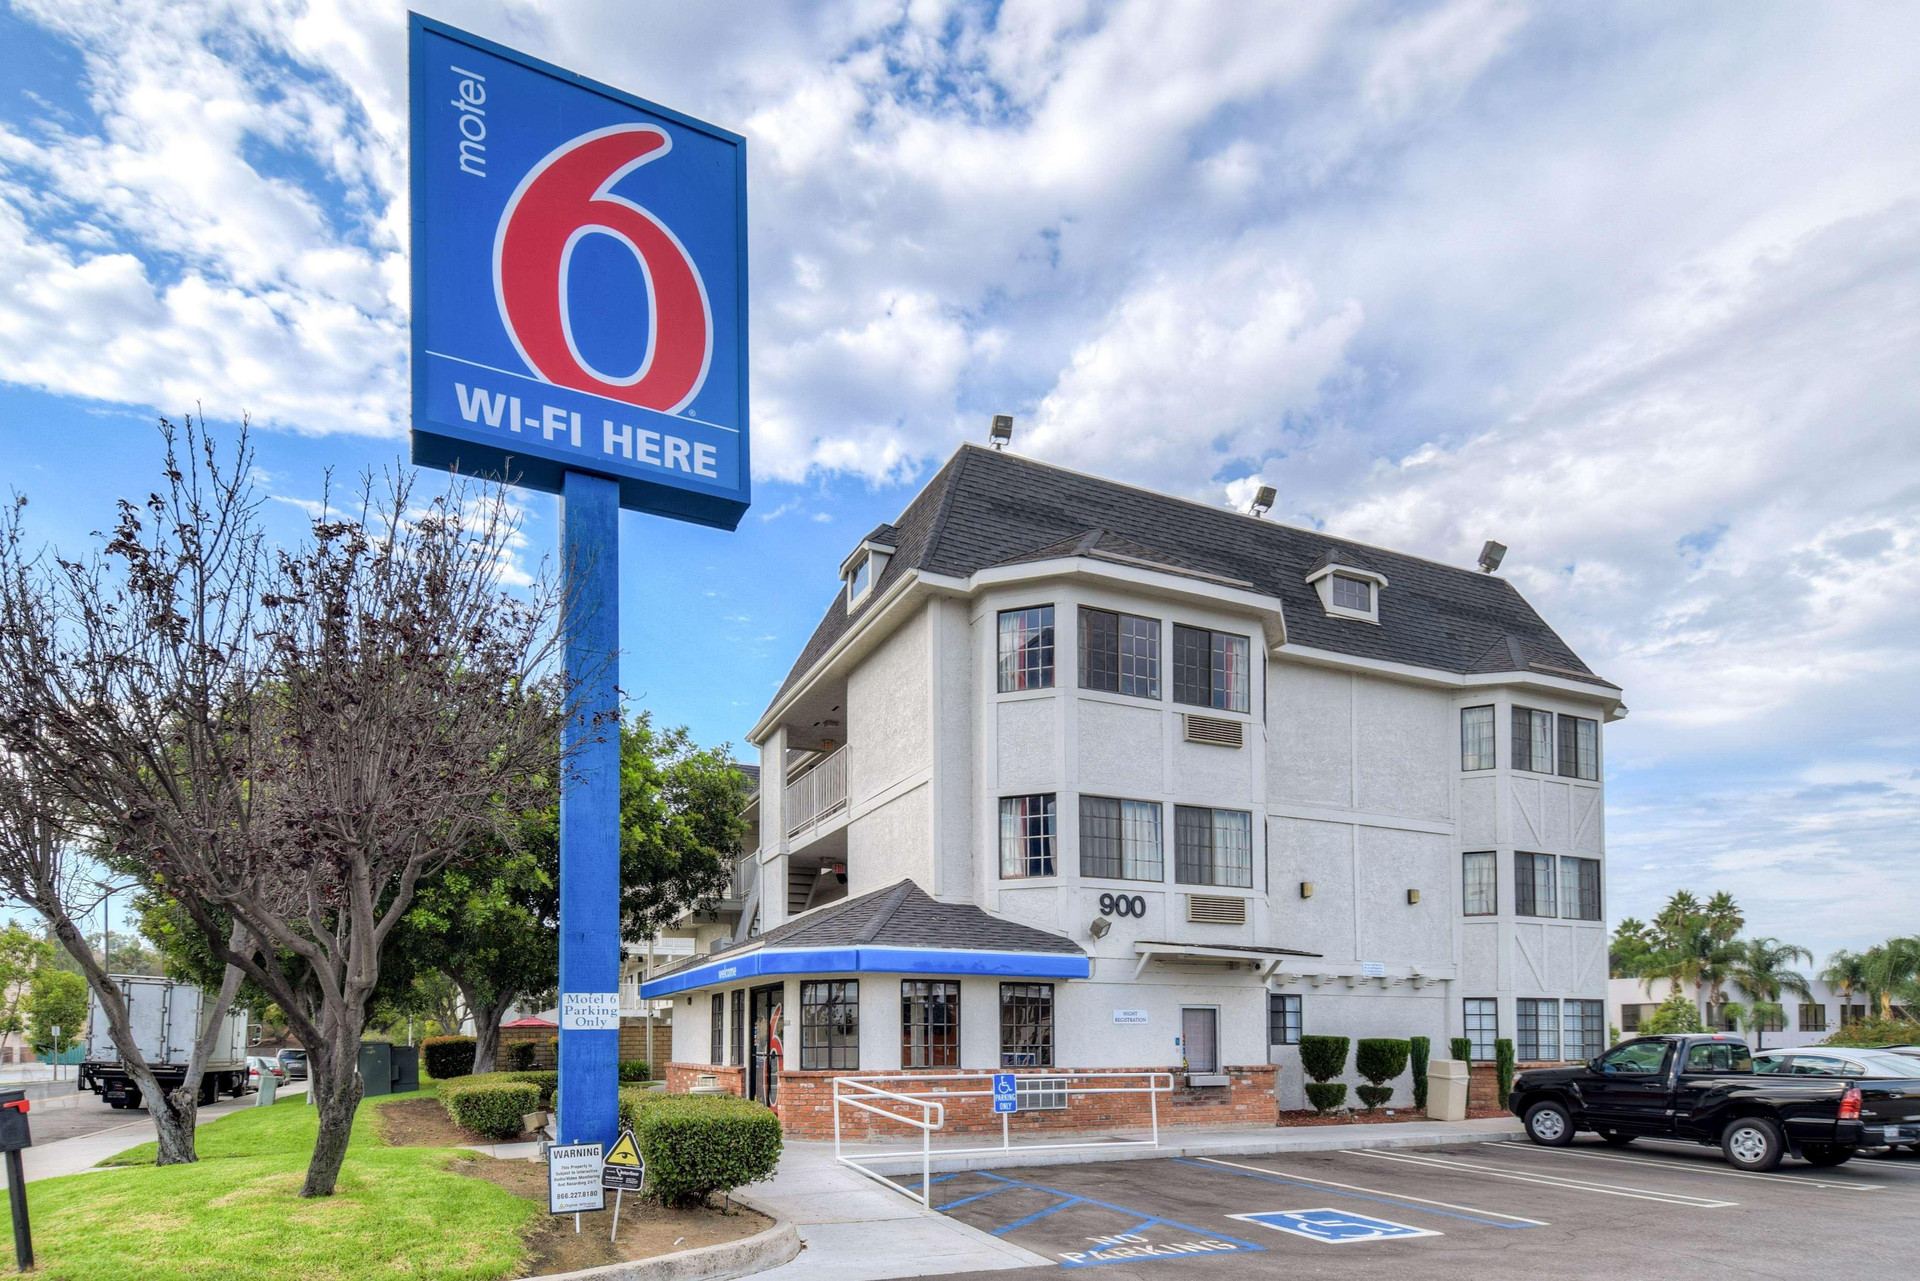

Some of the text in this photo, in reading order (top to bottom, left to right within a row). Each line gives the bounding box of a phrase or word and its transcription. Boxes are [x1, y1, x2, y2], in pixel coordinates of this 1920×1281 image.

[450, 65, 486, 178] motel
[492, 122, 714, 417] 6
[454, 382, 717, 479] WI-FI HERE
[1099, 893, 1146, 918] 900
[567, 994, 617, 1004] Motel 6
[564, 1005, 618, 1018] Parking
[575, 1016, 607, 1028] Only
[995, 1093, 1016, 1102] PARKING
[1000, 1102, 1012, 1110] ONLY
[553, 1148, 600, 1160] WARNING
[1085, 1233, 1149, 1246] NO
[1057, 1240, 1238, 1264] PARKING
